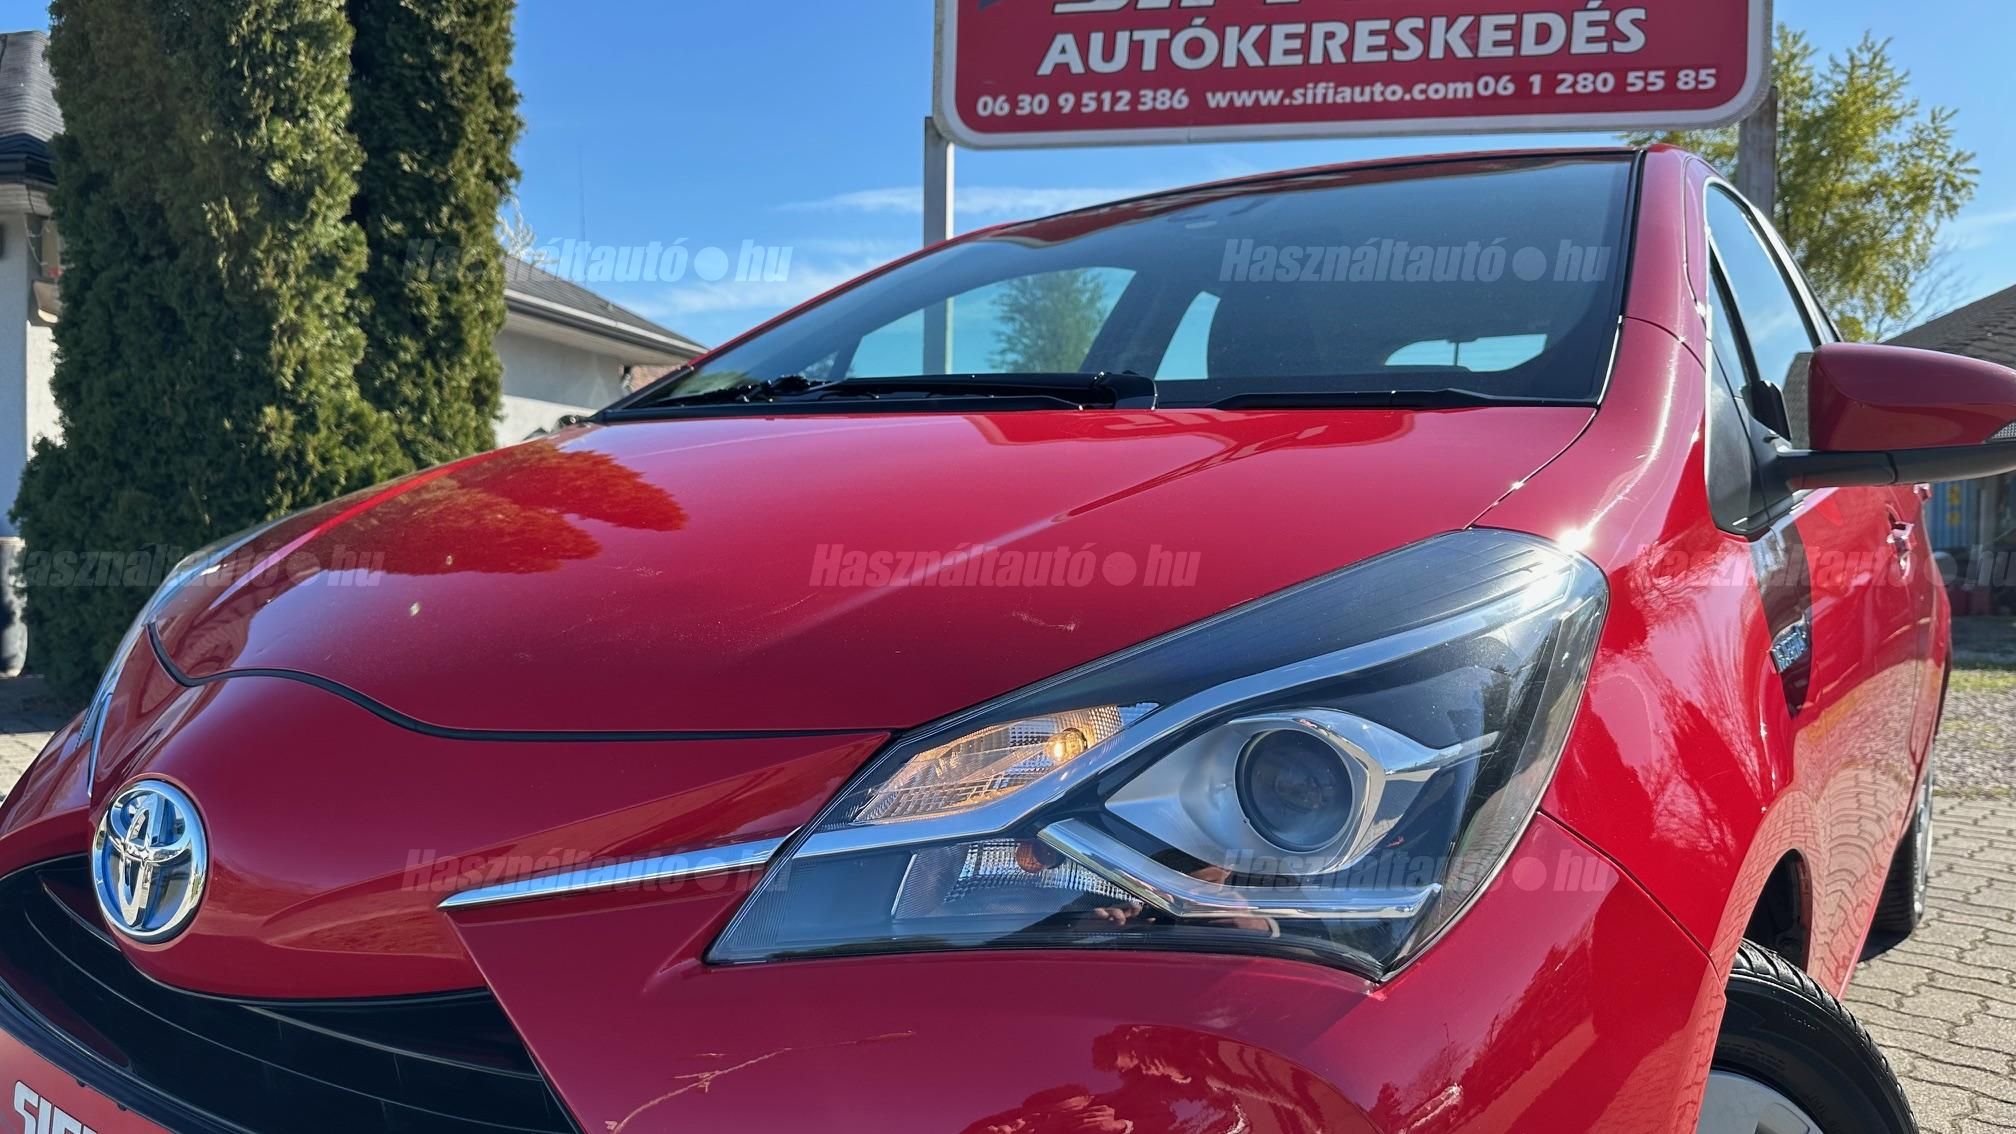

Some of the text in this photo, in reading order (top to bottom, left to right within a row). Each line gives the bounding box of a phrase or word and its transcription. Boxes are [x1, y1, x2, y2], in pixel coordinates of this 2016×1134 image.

[1036, 0, 1647, 76] AUTÓKERESKEDÉS
[976, 68, 1717, 117] 06 30 9 512 386 www.sifiauto.com 06 1 280 55 85
